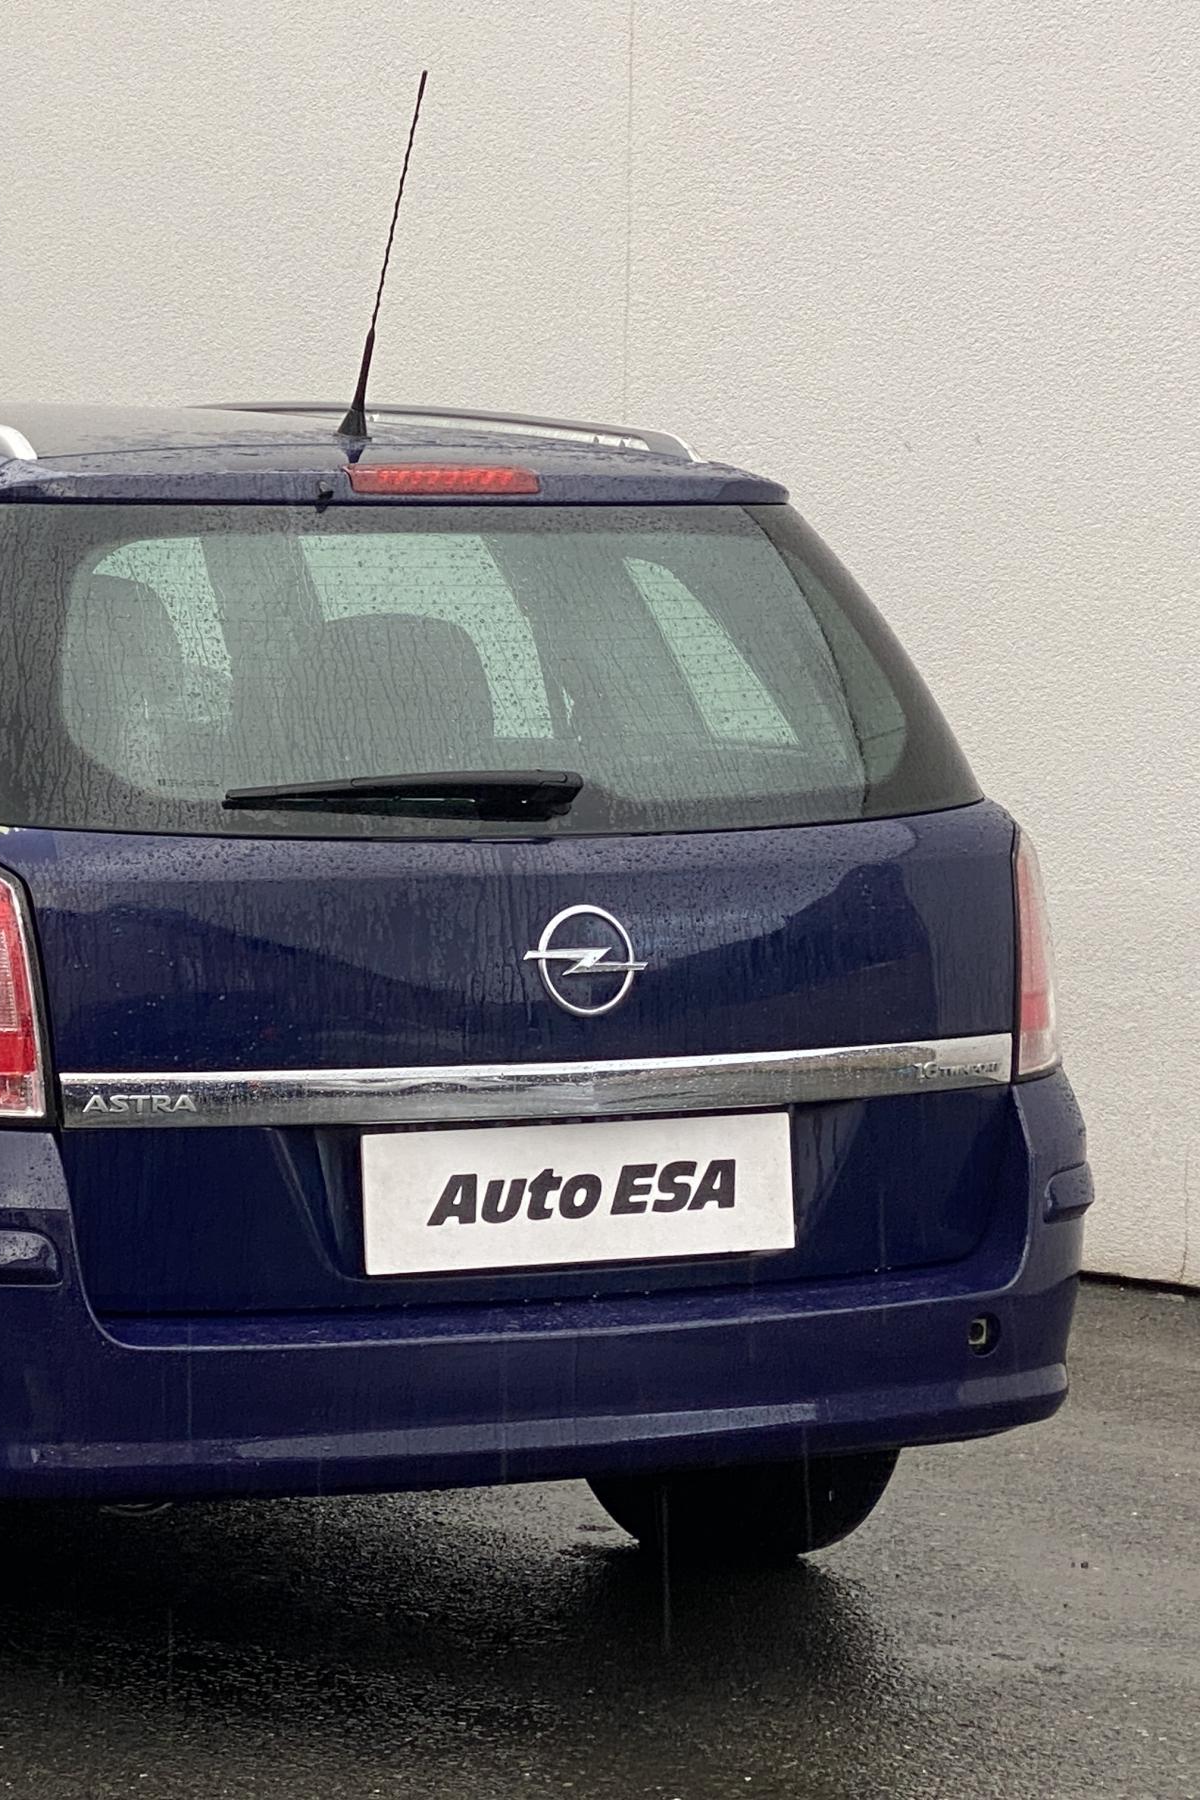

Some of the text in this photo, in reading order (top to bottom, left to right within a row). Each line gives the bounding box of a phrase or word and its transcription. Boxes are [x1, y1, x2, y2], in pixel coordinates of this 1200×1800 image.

[82, 1094, 197, 1113] ASTRA
[426, 1158, 736, 1226] Auto ESA
